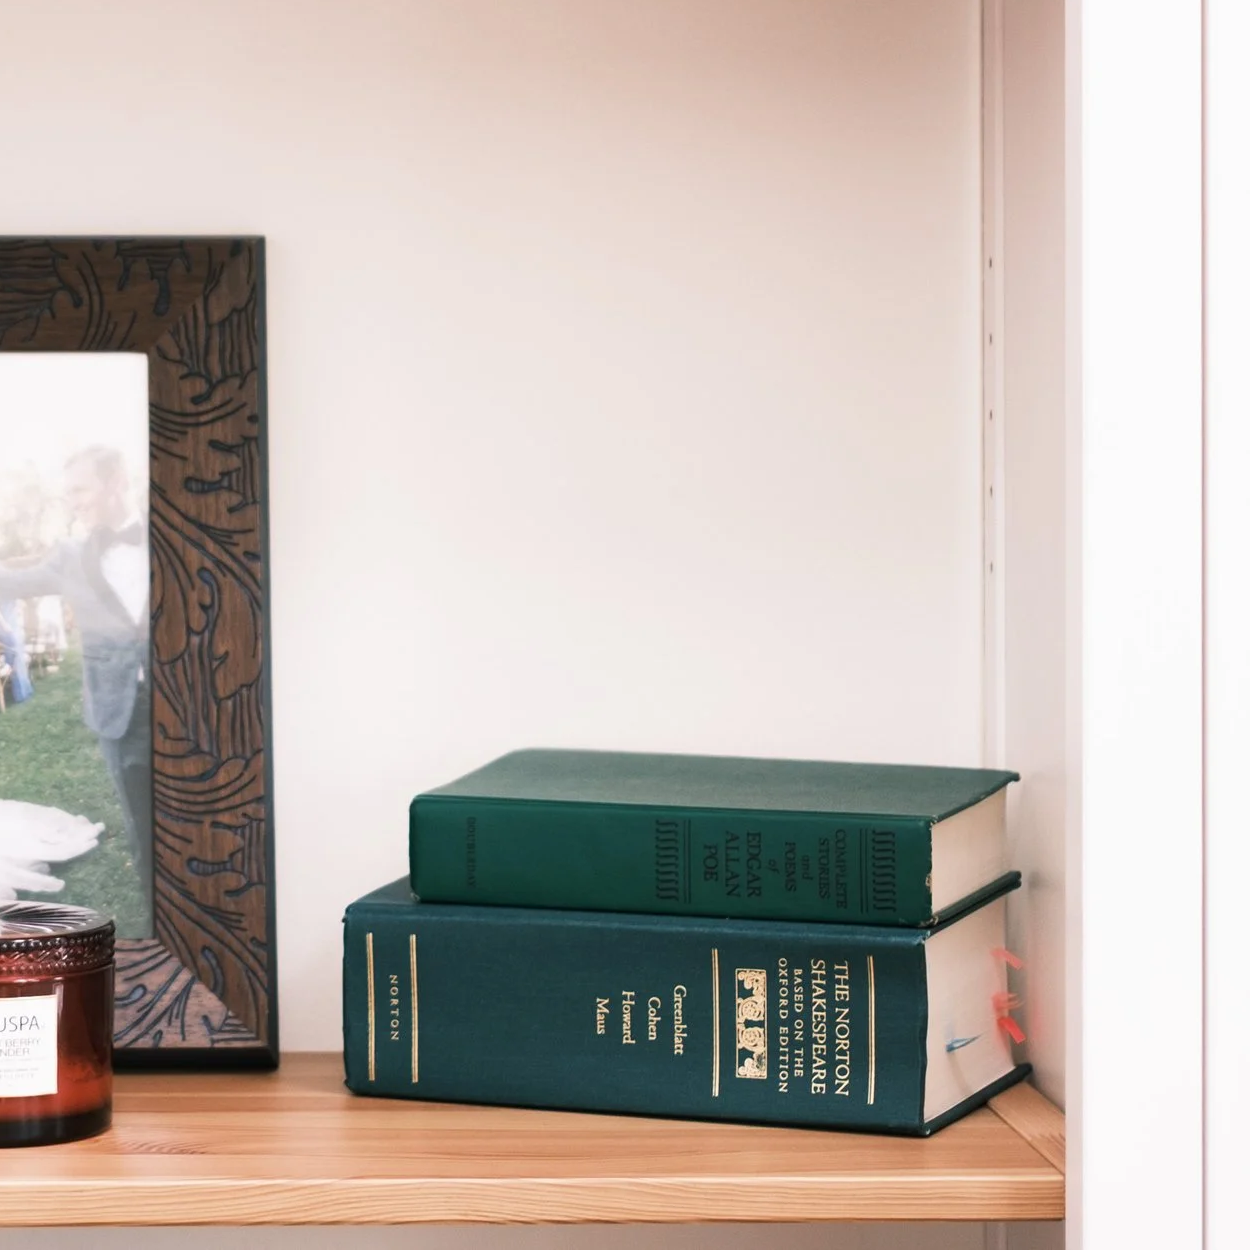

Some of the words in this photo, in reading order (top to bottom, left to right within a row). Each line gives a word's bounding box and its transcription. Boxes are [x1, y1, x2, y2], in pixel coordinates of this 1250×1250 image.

[466, 816, 477, 888] DOUBLEDAY
[703, 843, 719, 883] POE
[724, 830, 742, 898] ALLAN
[745, 830, 762, 898] EDGAR
[766, 858, 779, 875] of
[784, 841, 797, 893] POEMS
[800, 854, 813, 880] and
[818, 837, 831, 900] STORIES
[835, 828, 848, 910] COMPLETE
[389, 974, 400, 1041] NORTON
[778, 957, 789, 1020] OXFORD
[793, 968, 804, 1013] BASED
[833, 960, 849, 1001] THE
[4, 1037, 41, 1047] BERRY
[595, 997, 609, 1035] Maus
[622, 990, 636, 1045] Howard
[648, 996, 661, 1041] Cohen
[674, 984, 688, 1056] Greenblatt
[794, 1019, 804, 1041] ON
[810, 958, 827, 1095] SHAKESPEARE
[779, 1025, 789, 1094] EDITION
[794, 1046, 804, 1078] THE
[835, 1007, 851, 1097] NORTON
